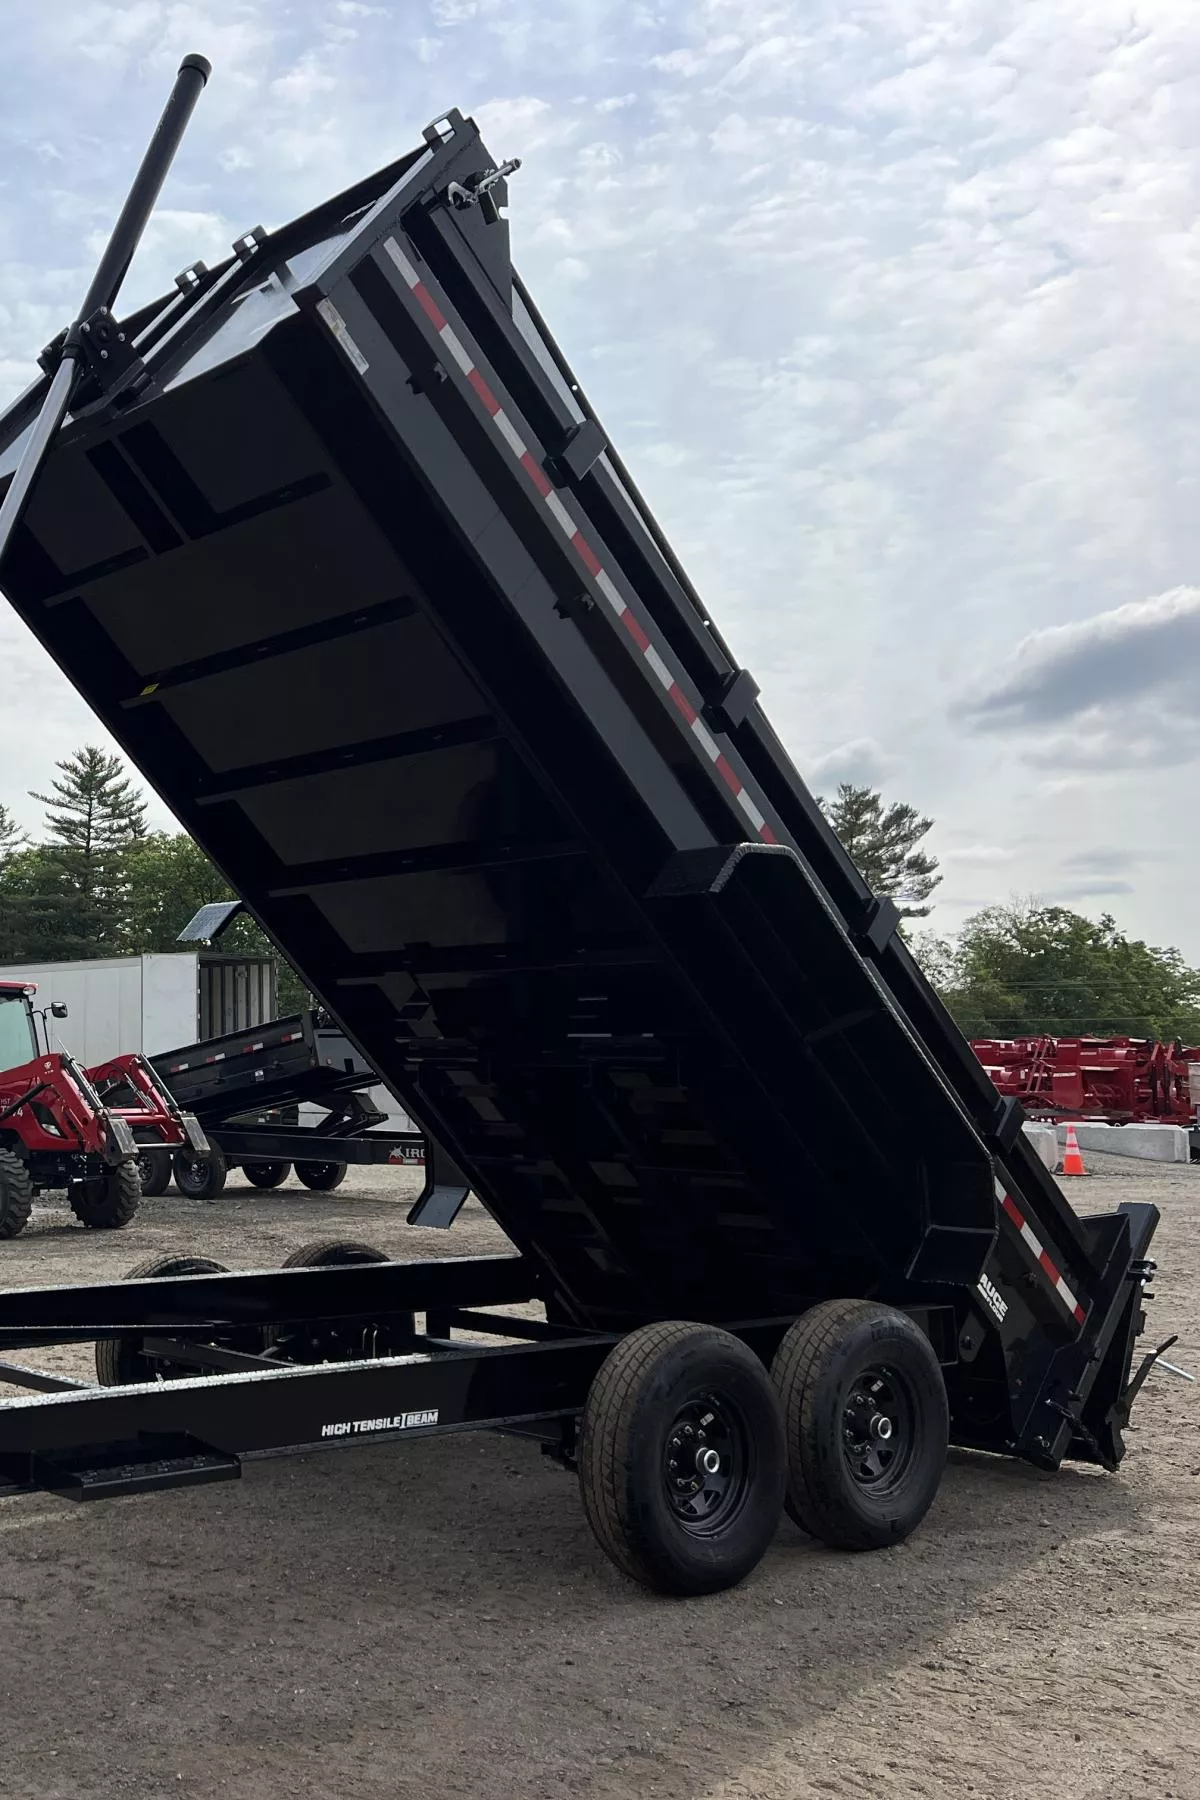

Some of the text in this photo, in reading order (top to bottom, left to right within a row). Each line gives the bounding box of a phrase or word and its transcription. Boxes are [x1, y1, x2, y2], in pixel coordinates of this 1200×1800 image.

[980, 1273, 1008, 1316] AUGE
[322, 1423, 351, 1436] HIGH
[353, 1416, 401, 1432] TENSILE
